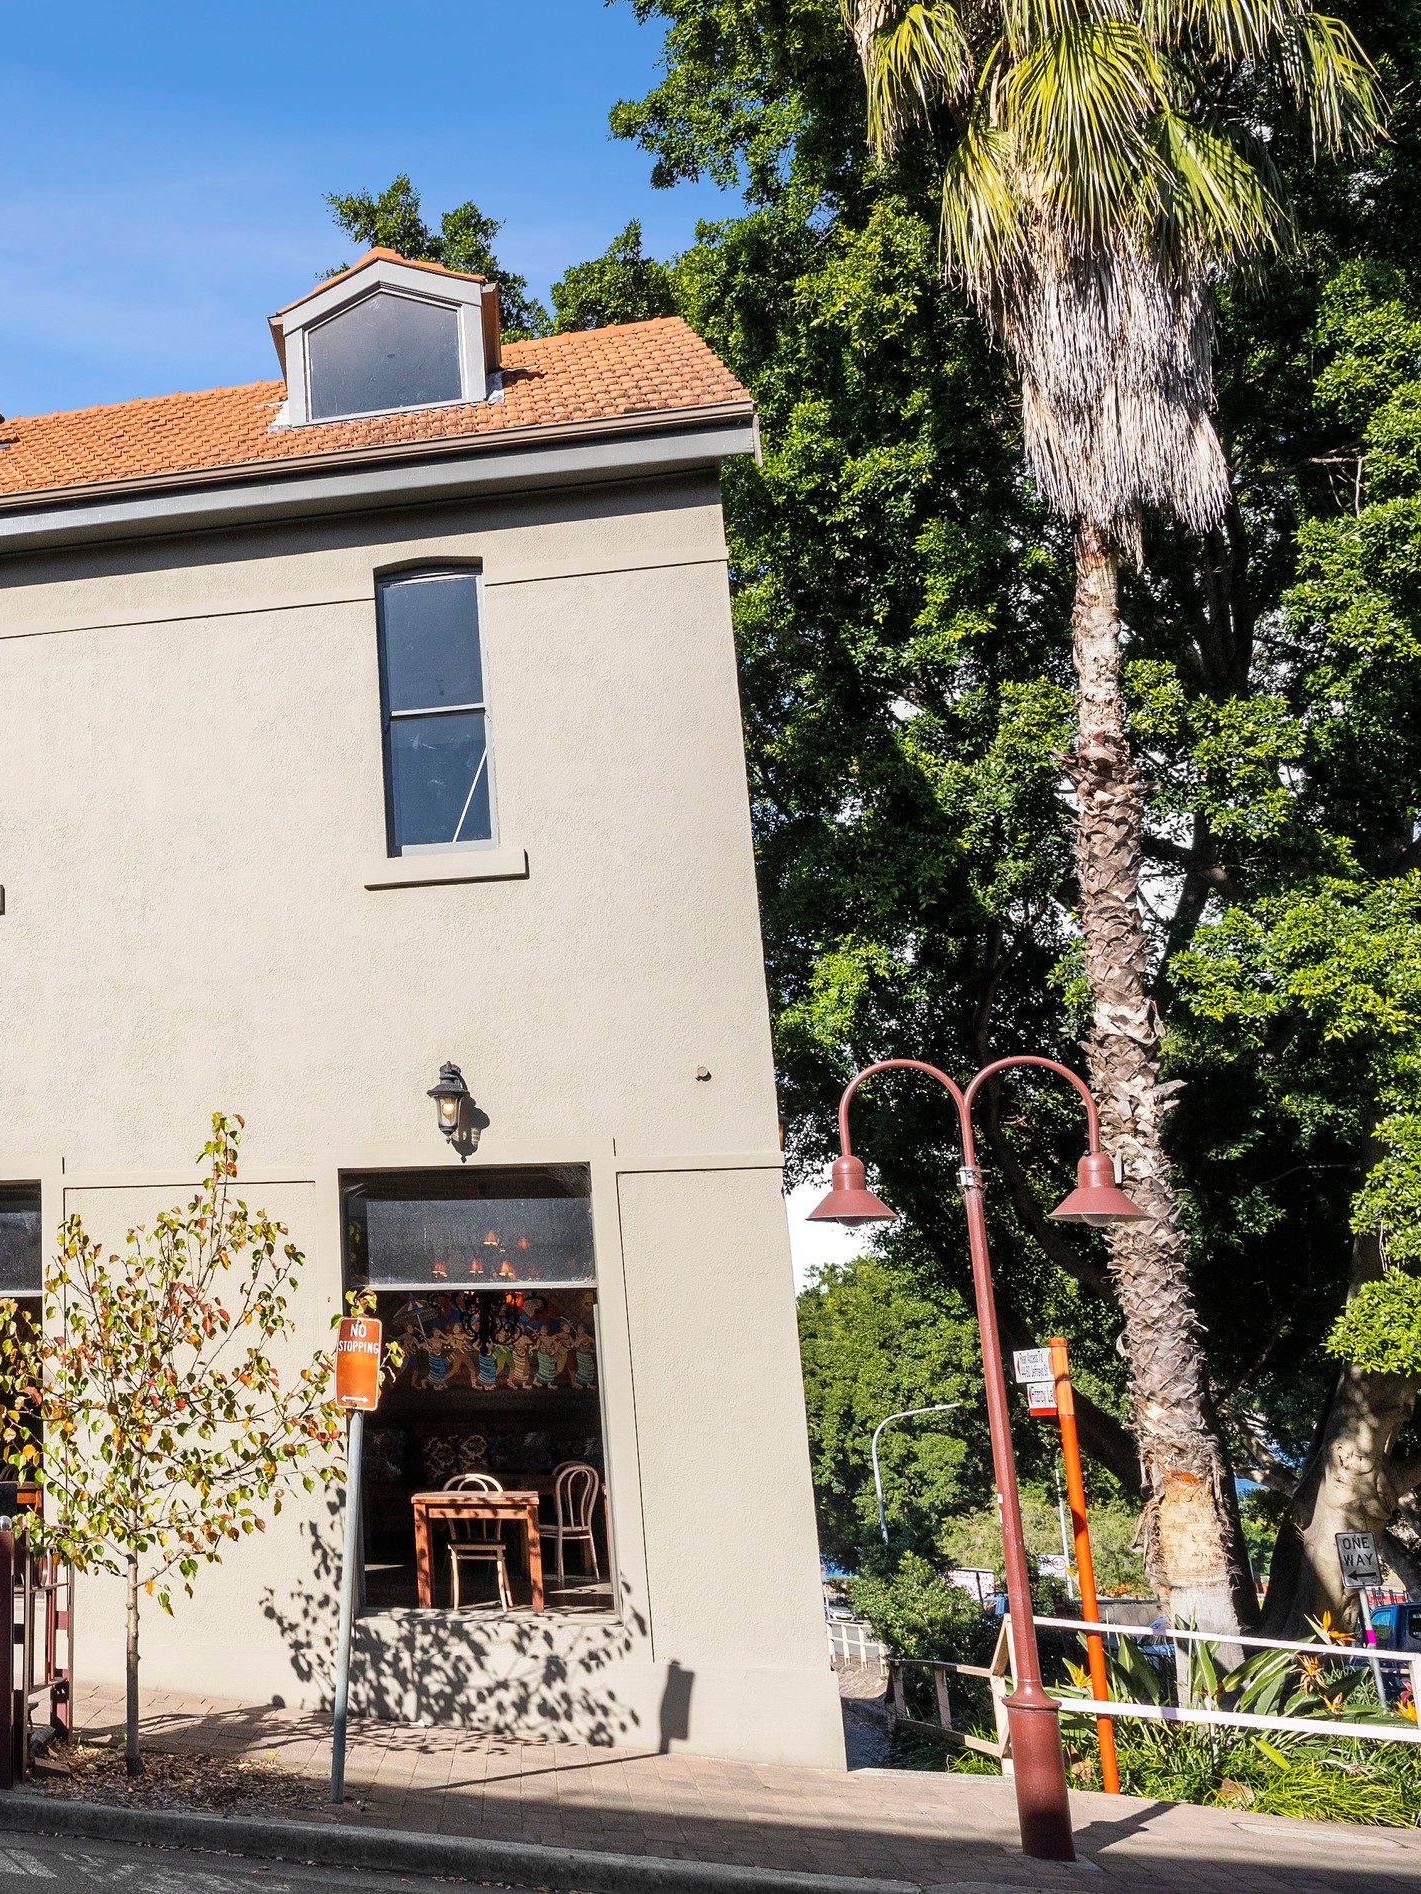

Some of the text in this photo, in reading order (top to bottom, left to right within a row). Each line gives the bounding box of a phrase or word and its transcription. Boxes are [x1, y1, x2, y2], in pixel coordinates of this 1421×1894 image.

[350, 1324, 367, 1338] NO
[338, 1340, 379, 1354] STOPPING
[1342, 1536, 1370, 1550] ONE
[1343, 1553, 1373, 1566] WAY
